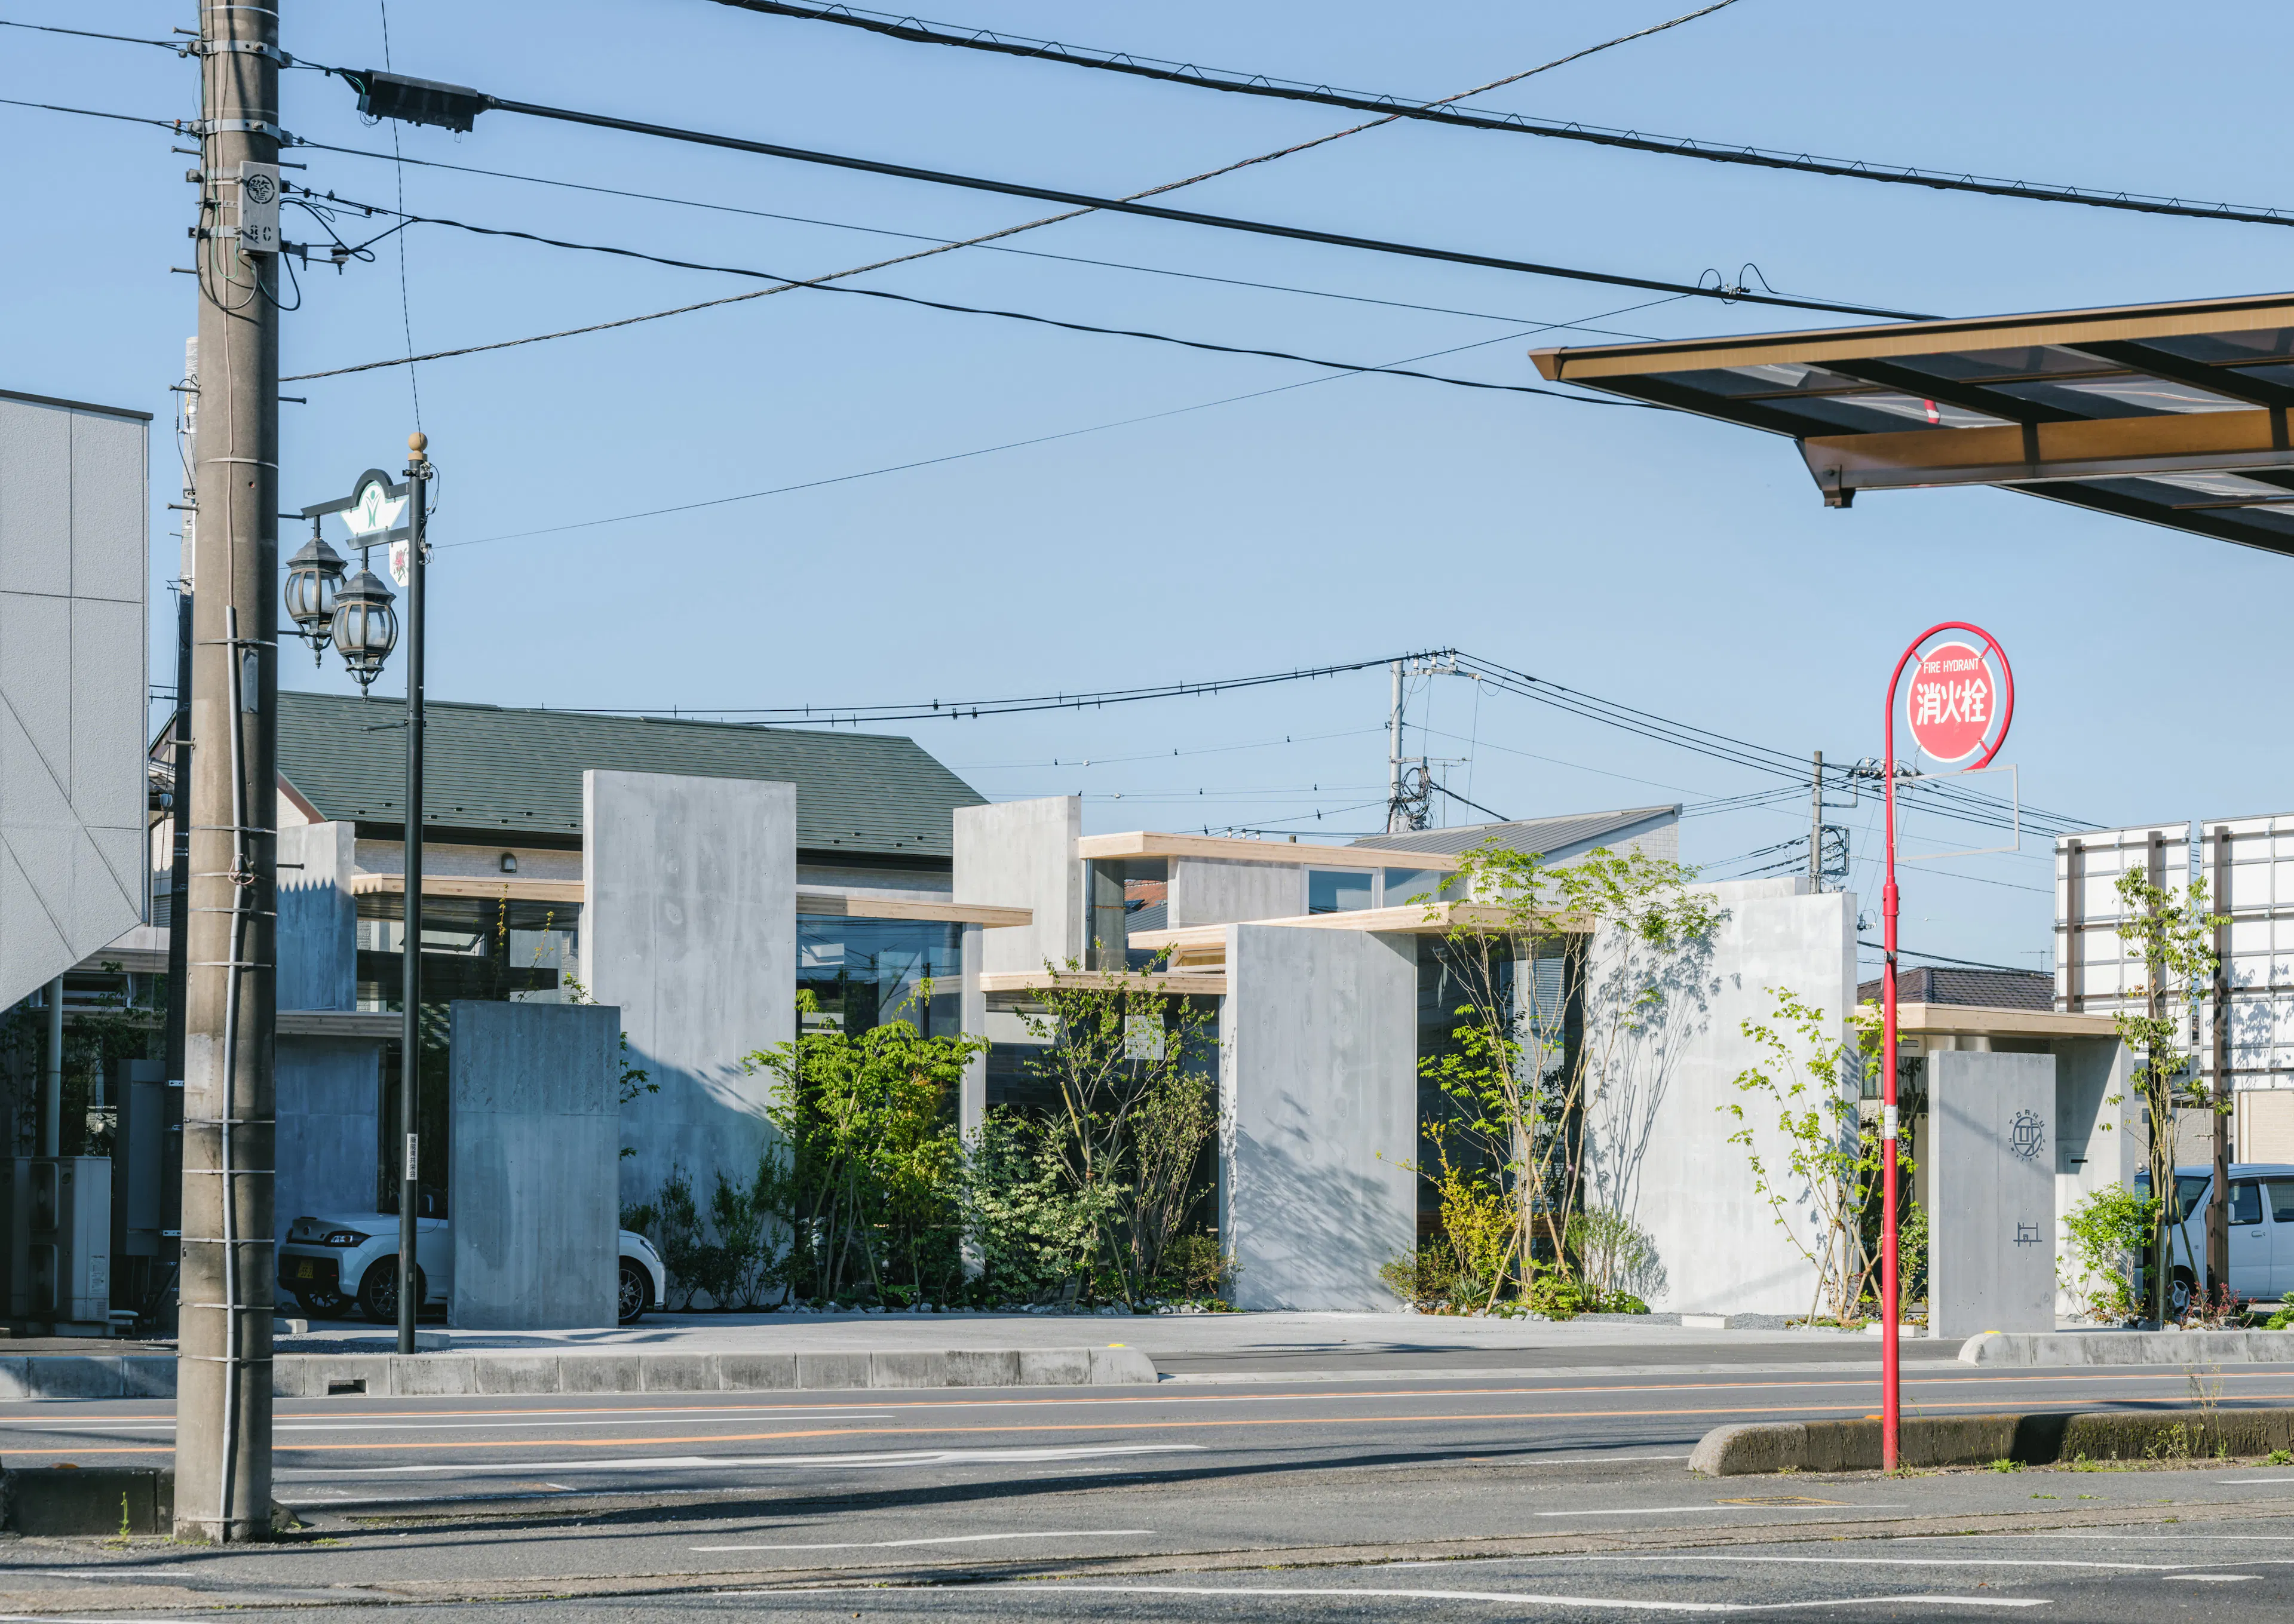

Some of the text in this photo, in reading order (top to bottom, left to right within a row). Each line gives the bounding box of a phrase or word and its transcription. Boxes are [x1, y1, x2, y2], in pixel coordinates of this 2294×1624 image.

[1923, 658, 1979, 674] FIRE HYDRANT
[1916, 678, 1988, 726] 消火栓
